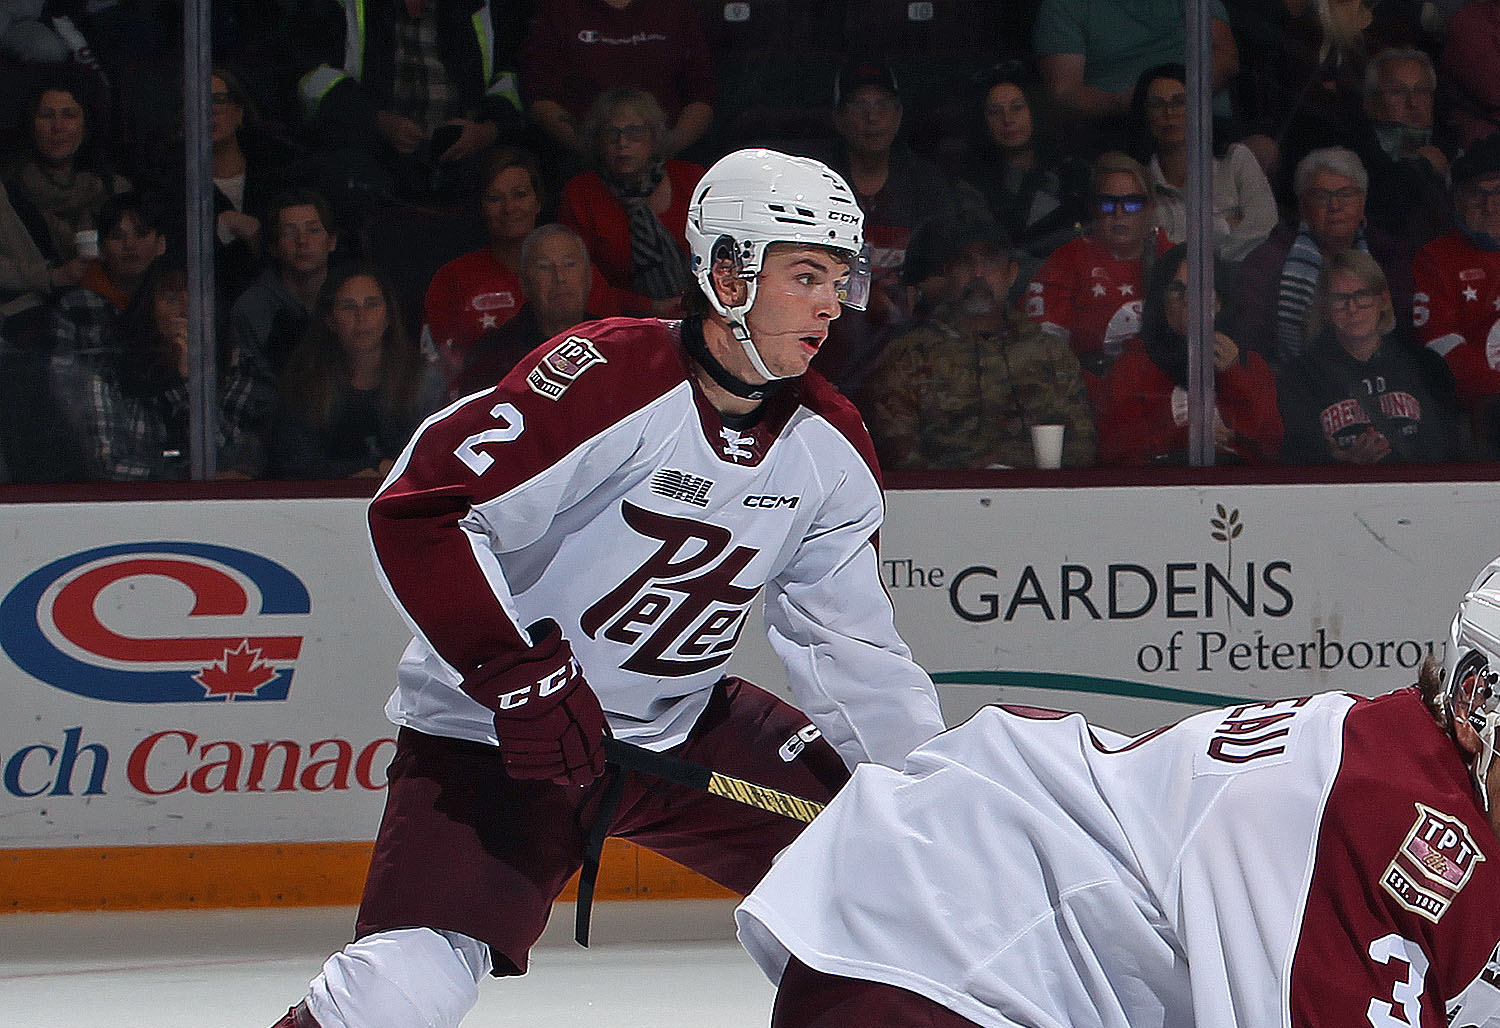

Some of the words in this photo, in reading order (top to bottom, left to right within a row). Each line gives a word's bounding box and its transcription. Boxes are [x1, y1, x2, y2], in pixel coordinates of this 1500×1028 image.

[559, 341, 596, 365] TPT
[453, 402, 527, 477] 2
[742, 495, 799, 509] CCM
[883, 560, 945, 588] The
[948, 560, 1294, 623] GARDENS
[1137, 631, 1183, 672] of
[1424, 818, 1472, 864] TPT
[1389, 872, 1410, 899] EST.
